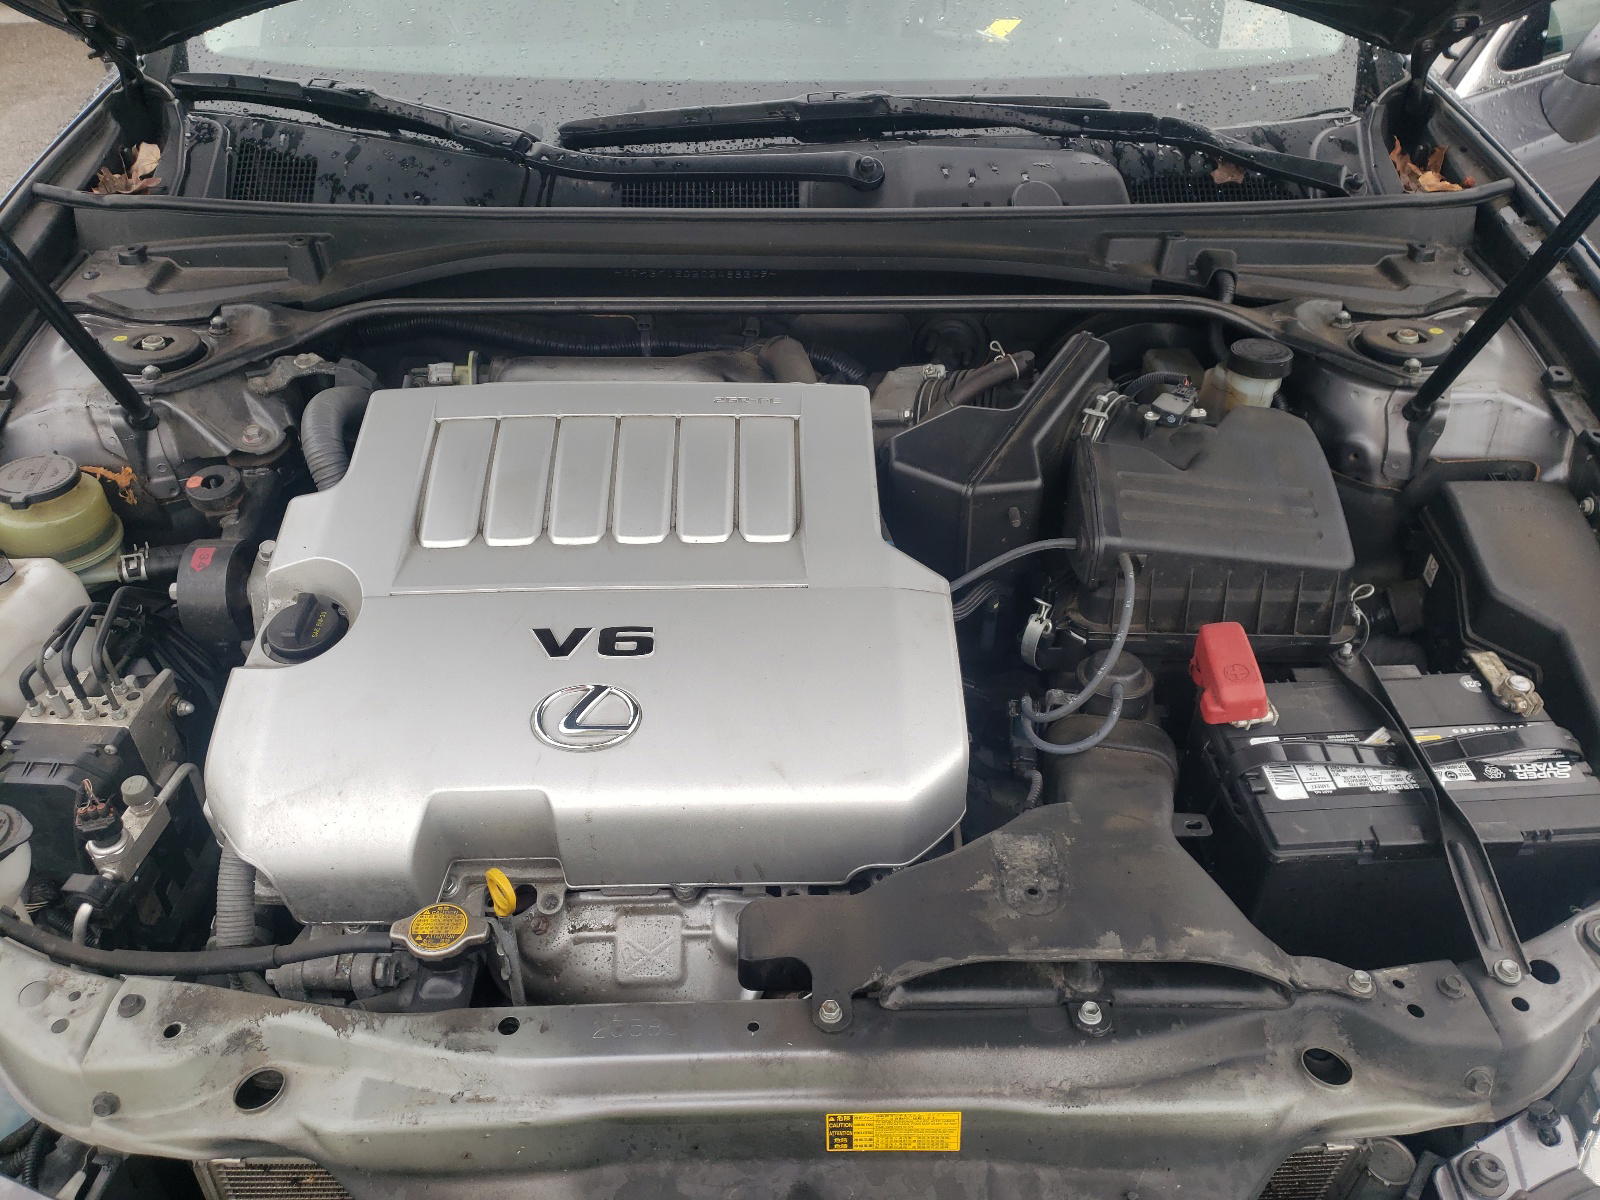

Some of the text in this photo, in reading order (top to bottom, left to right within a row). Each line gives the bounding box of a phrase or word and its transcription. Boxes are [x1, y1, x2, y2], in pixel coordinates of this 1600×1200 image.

[529, 626, 656, 660] V6
[1512, 761, 1573, 772] START
[1516, 770, 1571, 780] SUPER
